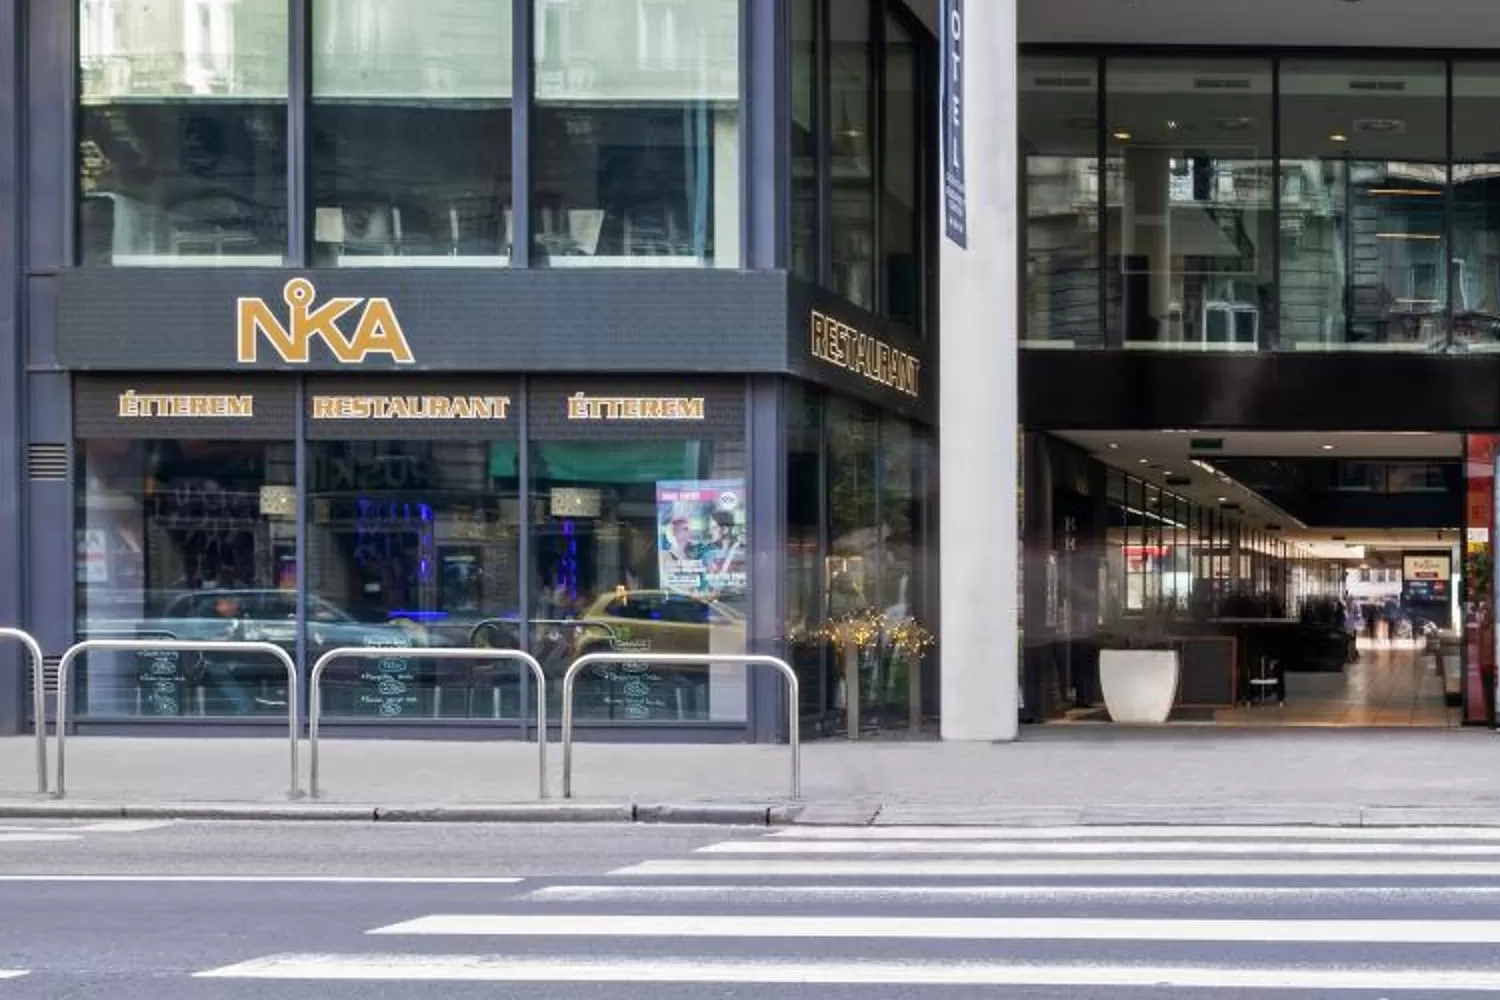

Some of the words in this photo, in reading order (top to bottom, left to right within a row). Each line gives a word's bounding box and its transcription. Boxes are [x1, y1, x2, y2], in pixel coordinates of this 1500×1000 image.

[811, 308, 920, 397] RESTAURANT
[118, 389, 253, 418] ÉTTEREM
[312, 395, 511, 420] RESTAURANT
[567, 392, 706, 420] ÉTTEREM
